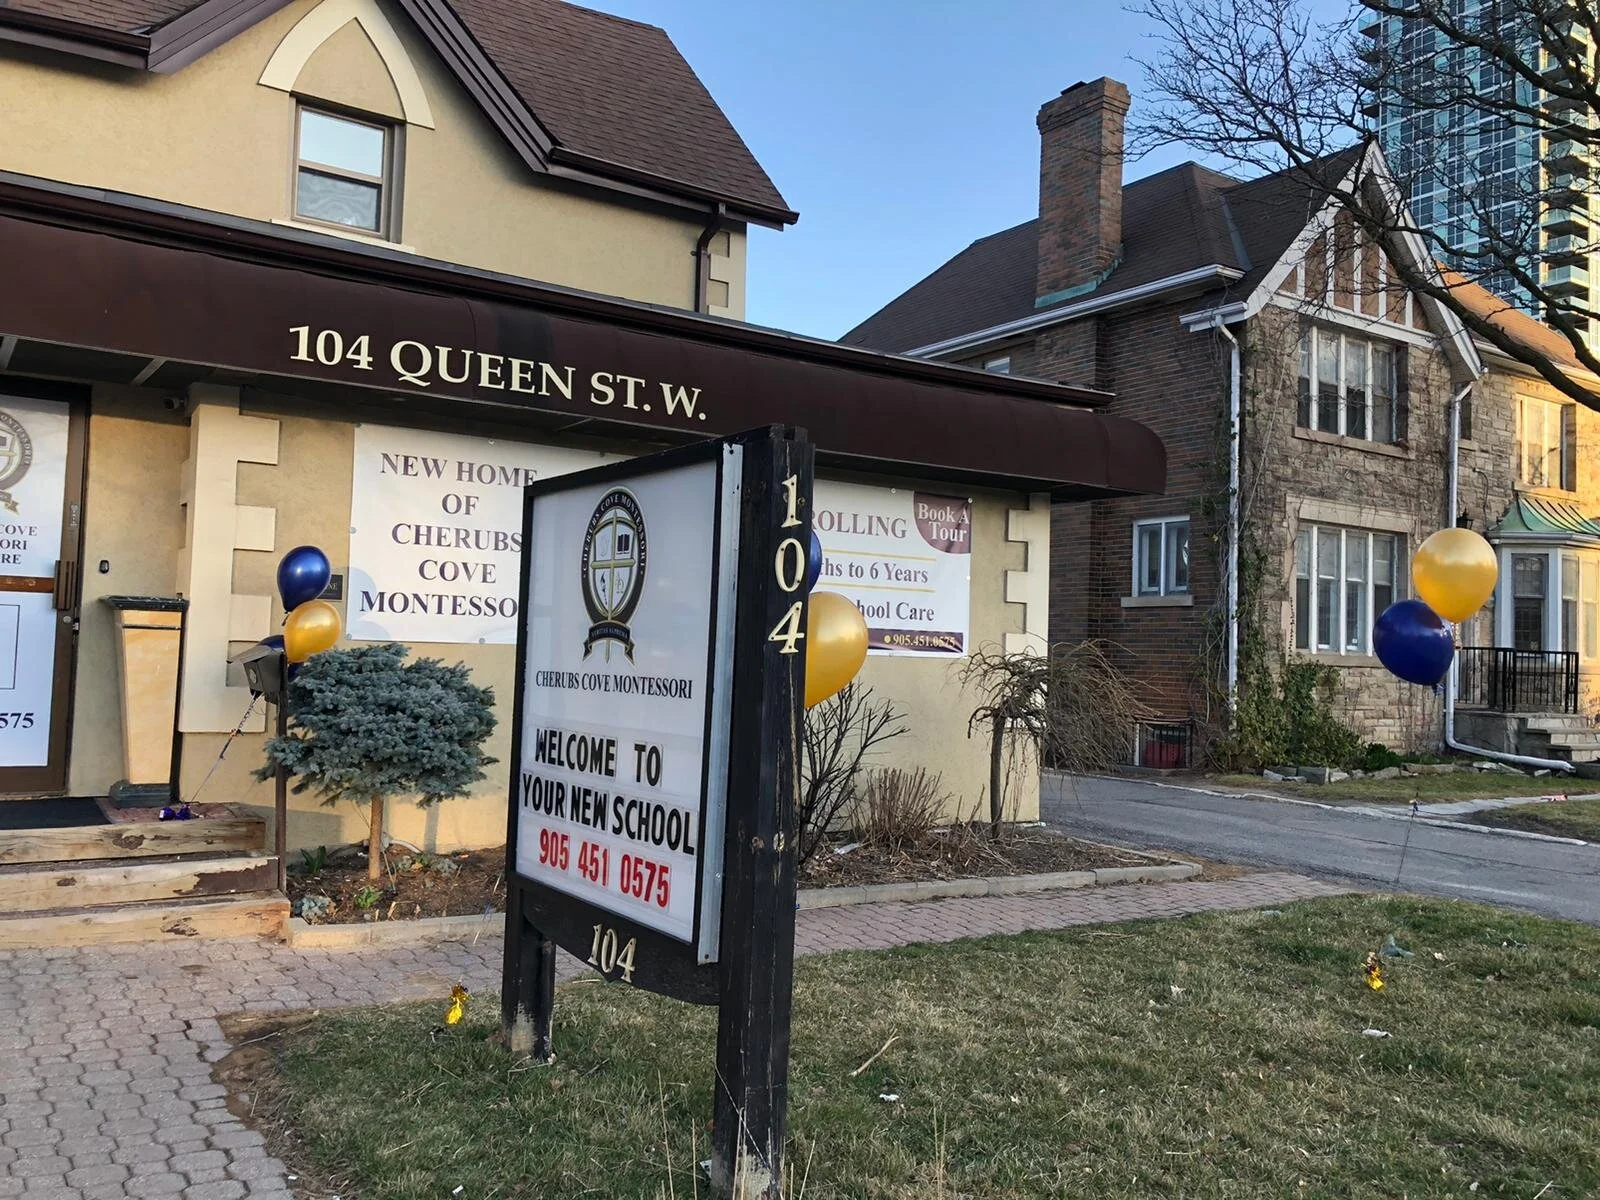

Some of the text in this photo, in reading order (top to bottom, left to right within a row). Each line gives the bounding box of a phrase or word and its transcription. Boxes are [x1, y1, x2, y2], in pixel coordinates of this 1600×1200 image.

[289, 325, 374, 370] 104
[390, 340, 576, 400] QUEEN
[380, 452, 538, 488] NEW HOME
[441, 493, 479, 515] OF
[917, 502, 970, 525] Book A
[391, 523, 523, 553] CHERUBS
[928, 521, 967, 543] Tour
[1, 553, 22, 564] RE
[418, 559, 496, 584] COVE
[849, 560, 864, 578] to
[869, 562, 879, 580] 6
[884, 562, 929, 584] Years
[359, 590, 518, 618] MONTESSO
[895, 601, 935, 621] Care
[536, 670, 693, 699] CHERUBS COVE MONTESSORI
[535, 728, 661, 786] WELCOME TO
[522, 773, 695, 855] YOUR NEW SCHOOL
[539, 828, 669, 908] 905 451 0575
[587, 924, 636, 983] 104
